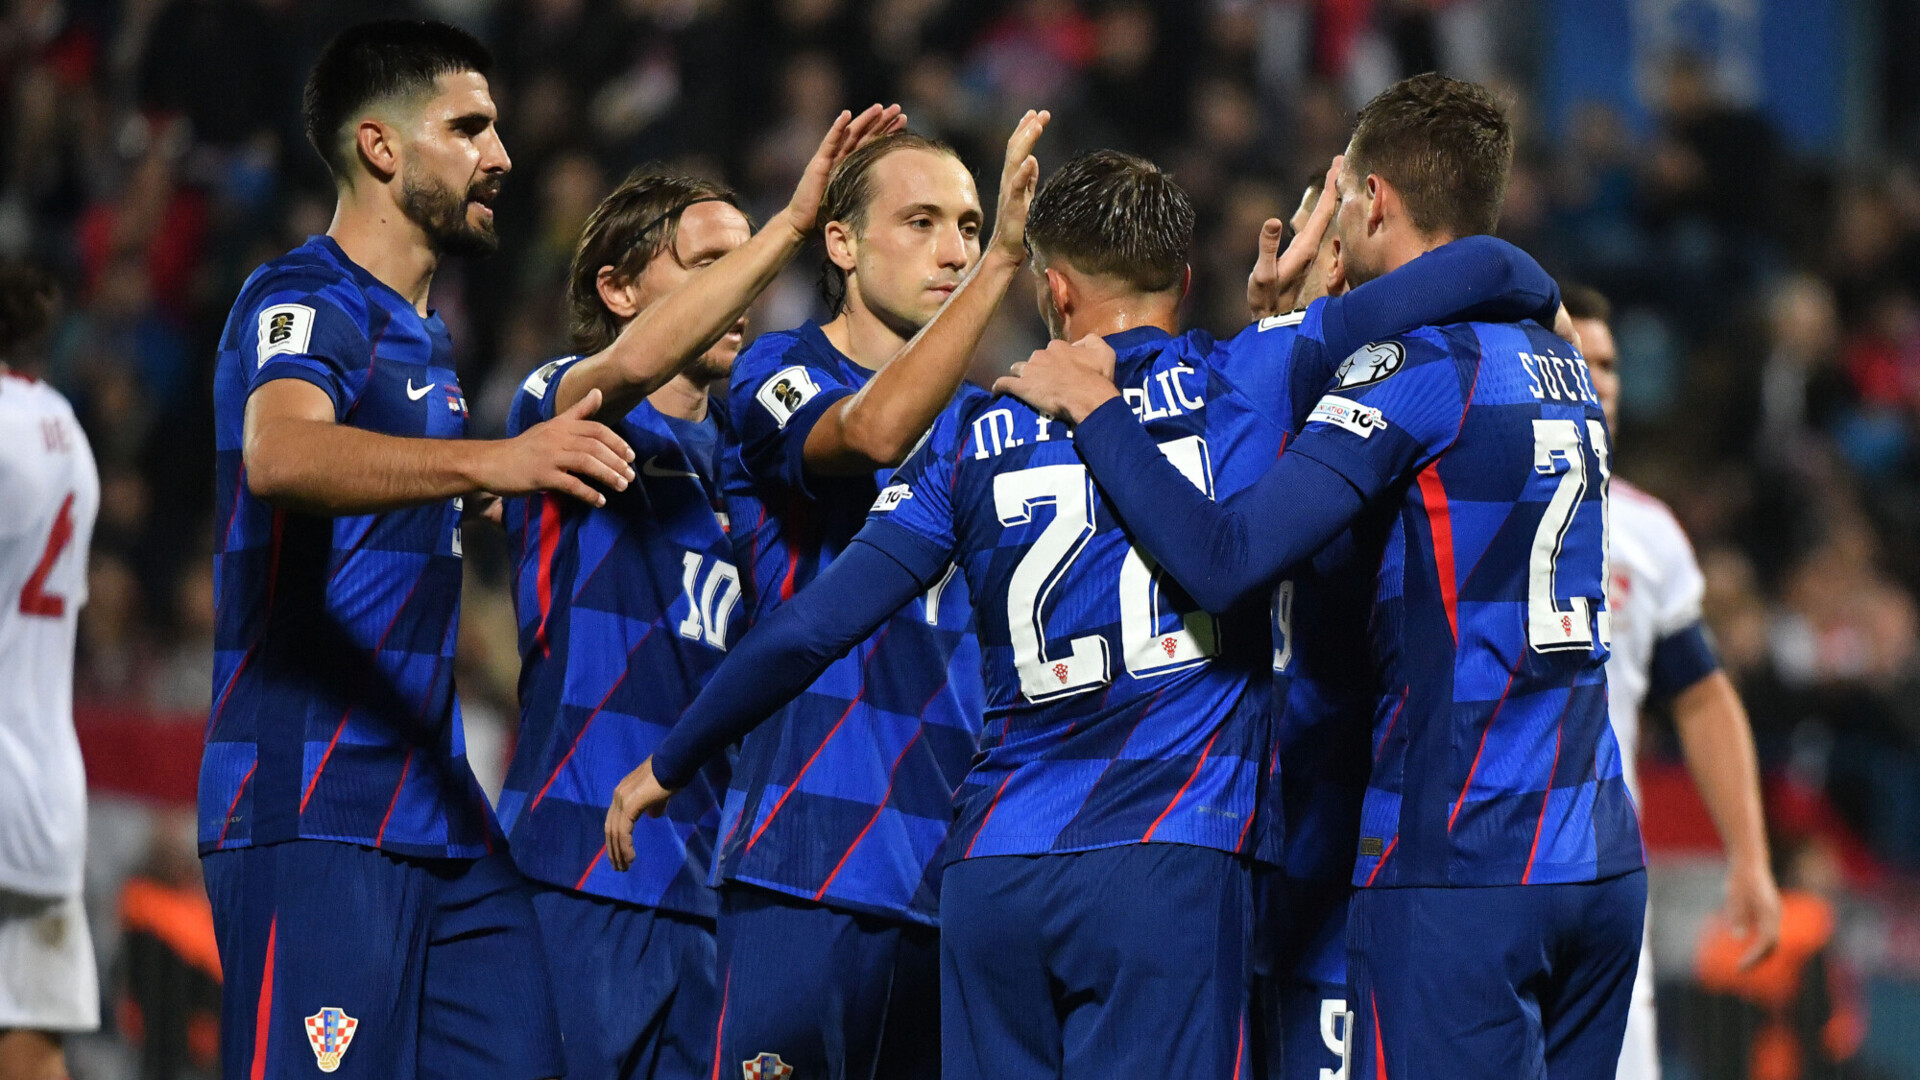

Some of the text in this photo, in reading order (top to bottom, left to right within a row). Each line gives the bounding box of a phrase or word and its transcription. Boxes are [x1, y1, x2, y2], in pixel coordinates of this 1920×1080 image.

[680, 550, 742, 652] 10
[993, 434, 1222, 704] 22
[1319, 998, 1354, 1080] 9
